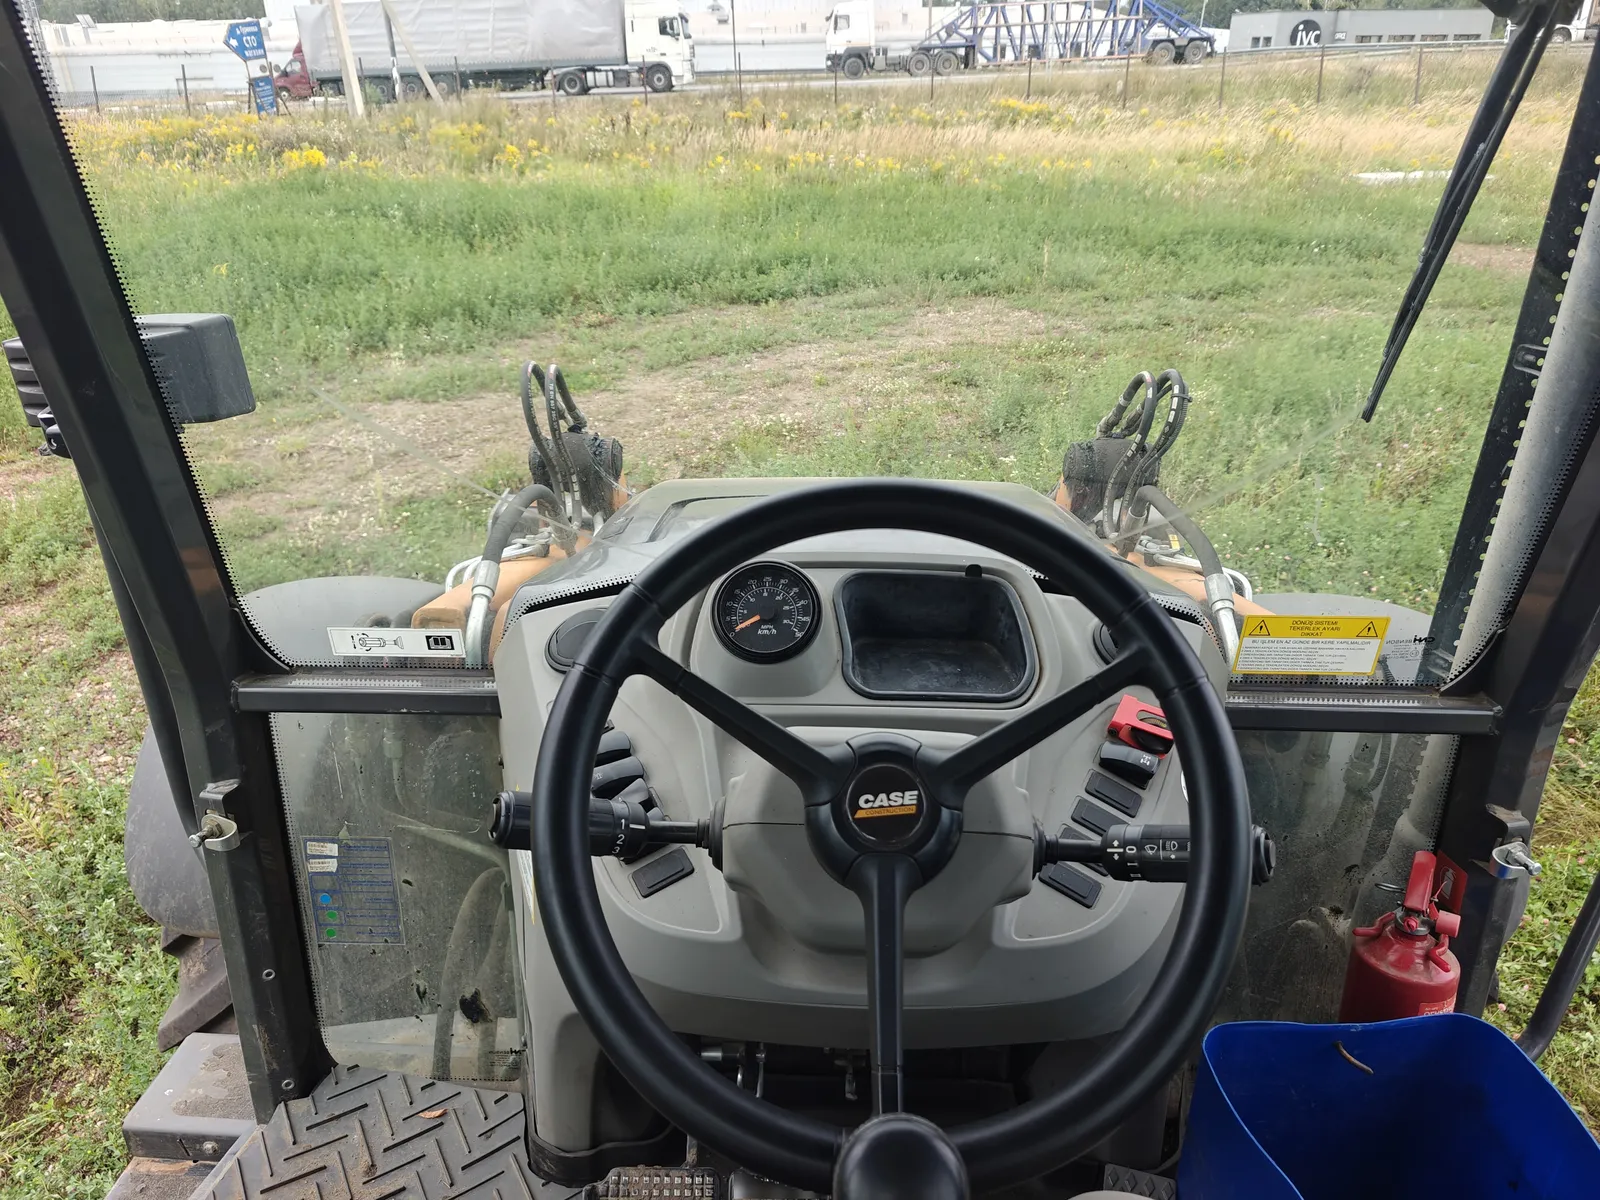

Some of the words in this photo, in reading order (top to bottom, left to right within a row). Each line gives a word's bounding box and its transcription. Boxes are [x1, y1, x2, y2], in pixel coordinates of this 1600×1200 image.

[242, 35, 257, 48] СТО
[858, 790, 919, 809] CASE
[864, 806, 914, 816] CONSTRUCTION
[620, 818, 626, 830] 1
[616, 833, 625, 845] 2
[611, 846, 620, 854] 3
